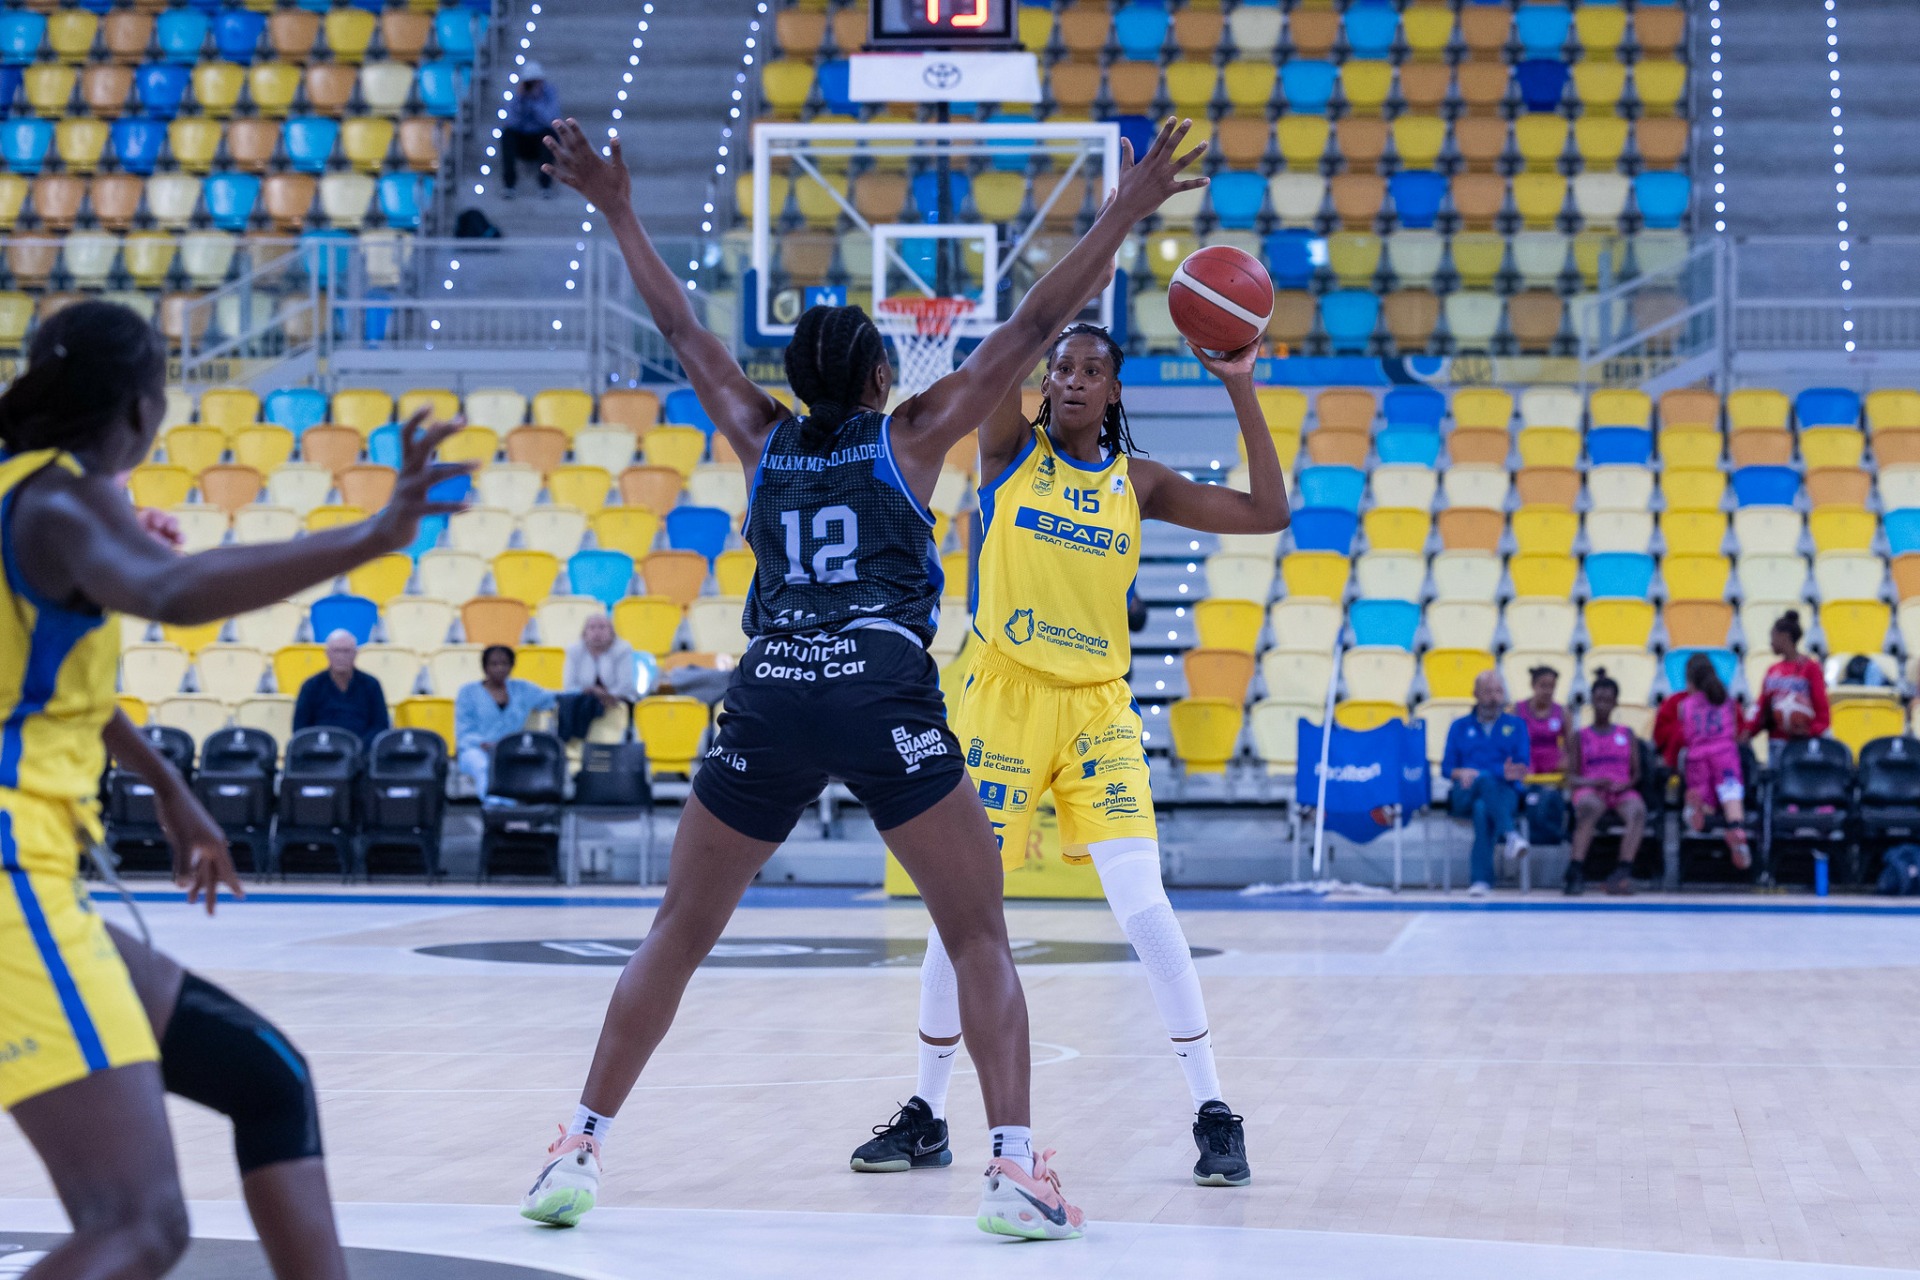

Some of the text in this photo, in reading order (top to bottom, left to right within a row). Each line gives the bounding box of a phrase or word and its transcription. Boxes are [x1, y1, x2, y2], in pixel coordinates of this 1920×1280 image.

[1063, 486, 1100, 514] 45
[1037, 514, 1111, 546] SPAR
[780, 504, 858, 585] 12
[1033, 532, 1107, 558] GRAN CANARIA
[823, 660, 867, 678] Car
[891, 726, 912, 743] EL
[896, 728, 942, 755] DIARIO
[901, 742, 948, 766] VASCO
[985, 751, 1025, 765] Gobierno
[983, 759, 1031, 775] de Canarias
